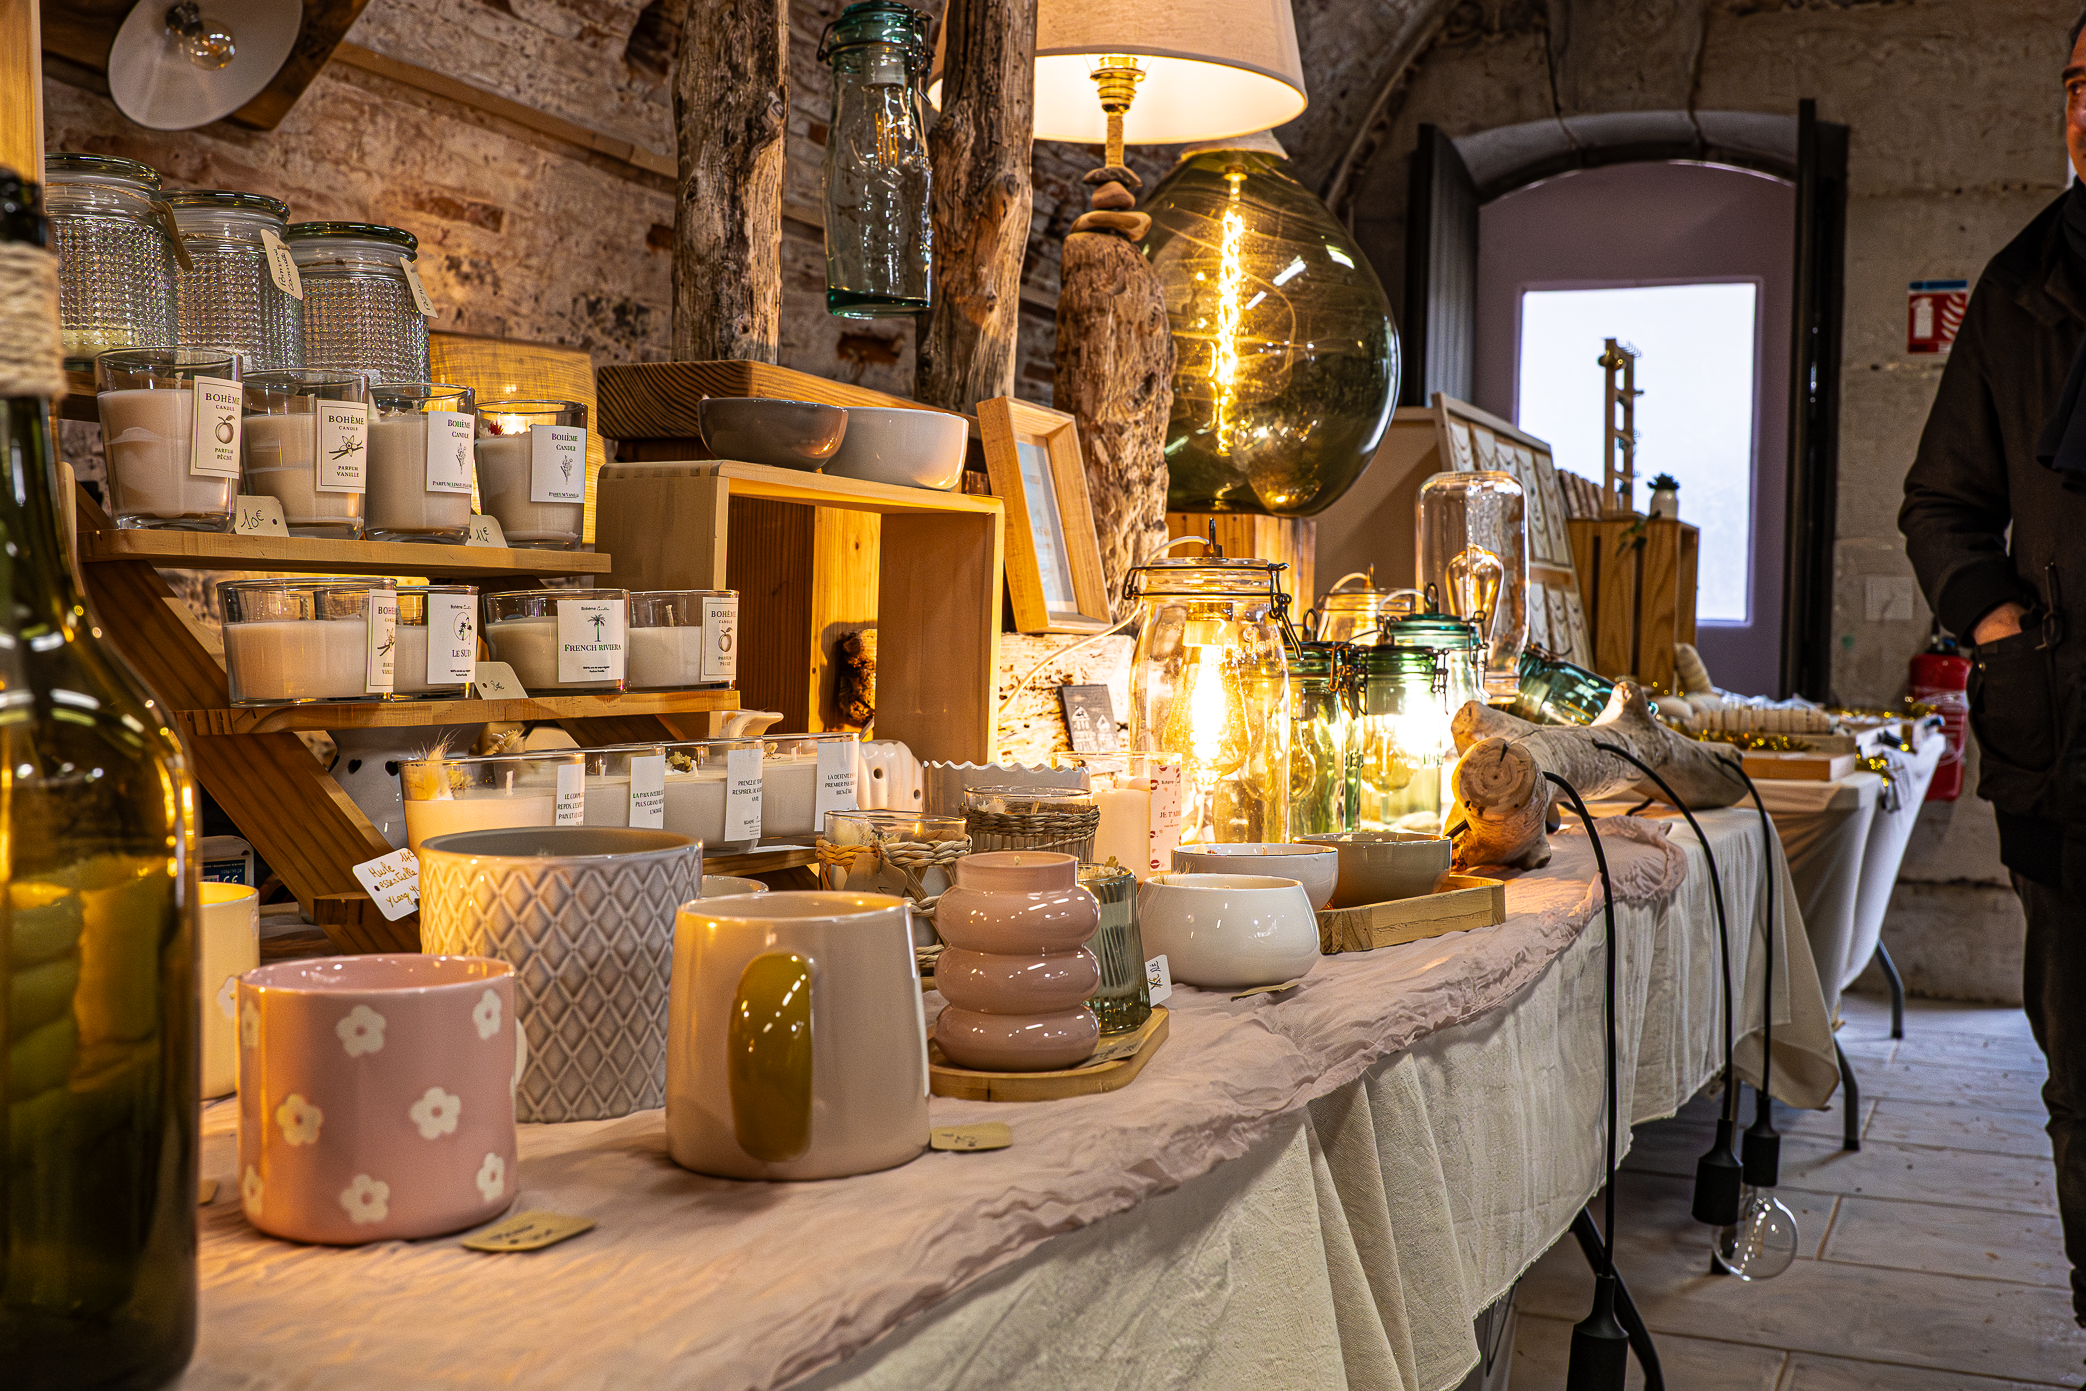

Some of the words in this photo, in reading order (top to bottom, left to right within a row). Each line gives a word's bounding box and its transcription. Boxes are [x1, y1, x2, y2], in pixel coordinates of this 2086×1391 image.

[205, 392, 240, 406] BOHÈME
[328, 414, 365, 425] BOHÈME
[551, 432, 579, 442] BOHÈME
[240, 508, 265, 530] 10€
[452, 649, 461, 658] LE
[460, 649, 472, 658] SUD
[564, 643, 597, 652] FRENCH
[598, 643, 622, 651] RIVIERA
[367, 861, 396, 878] Huile
[378, 866, 419, 889] essentielle
